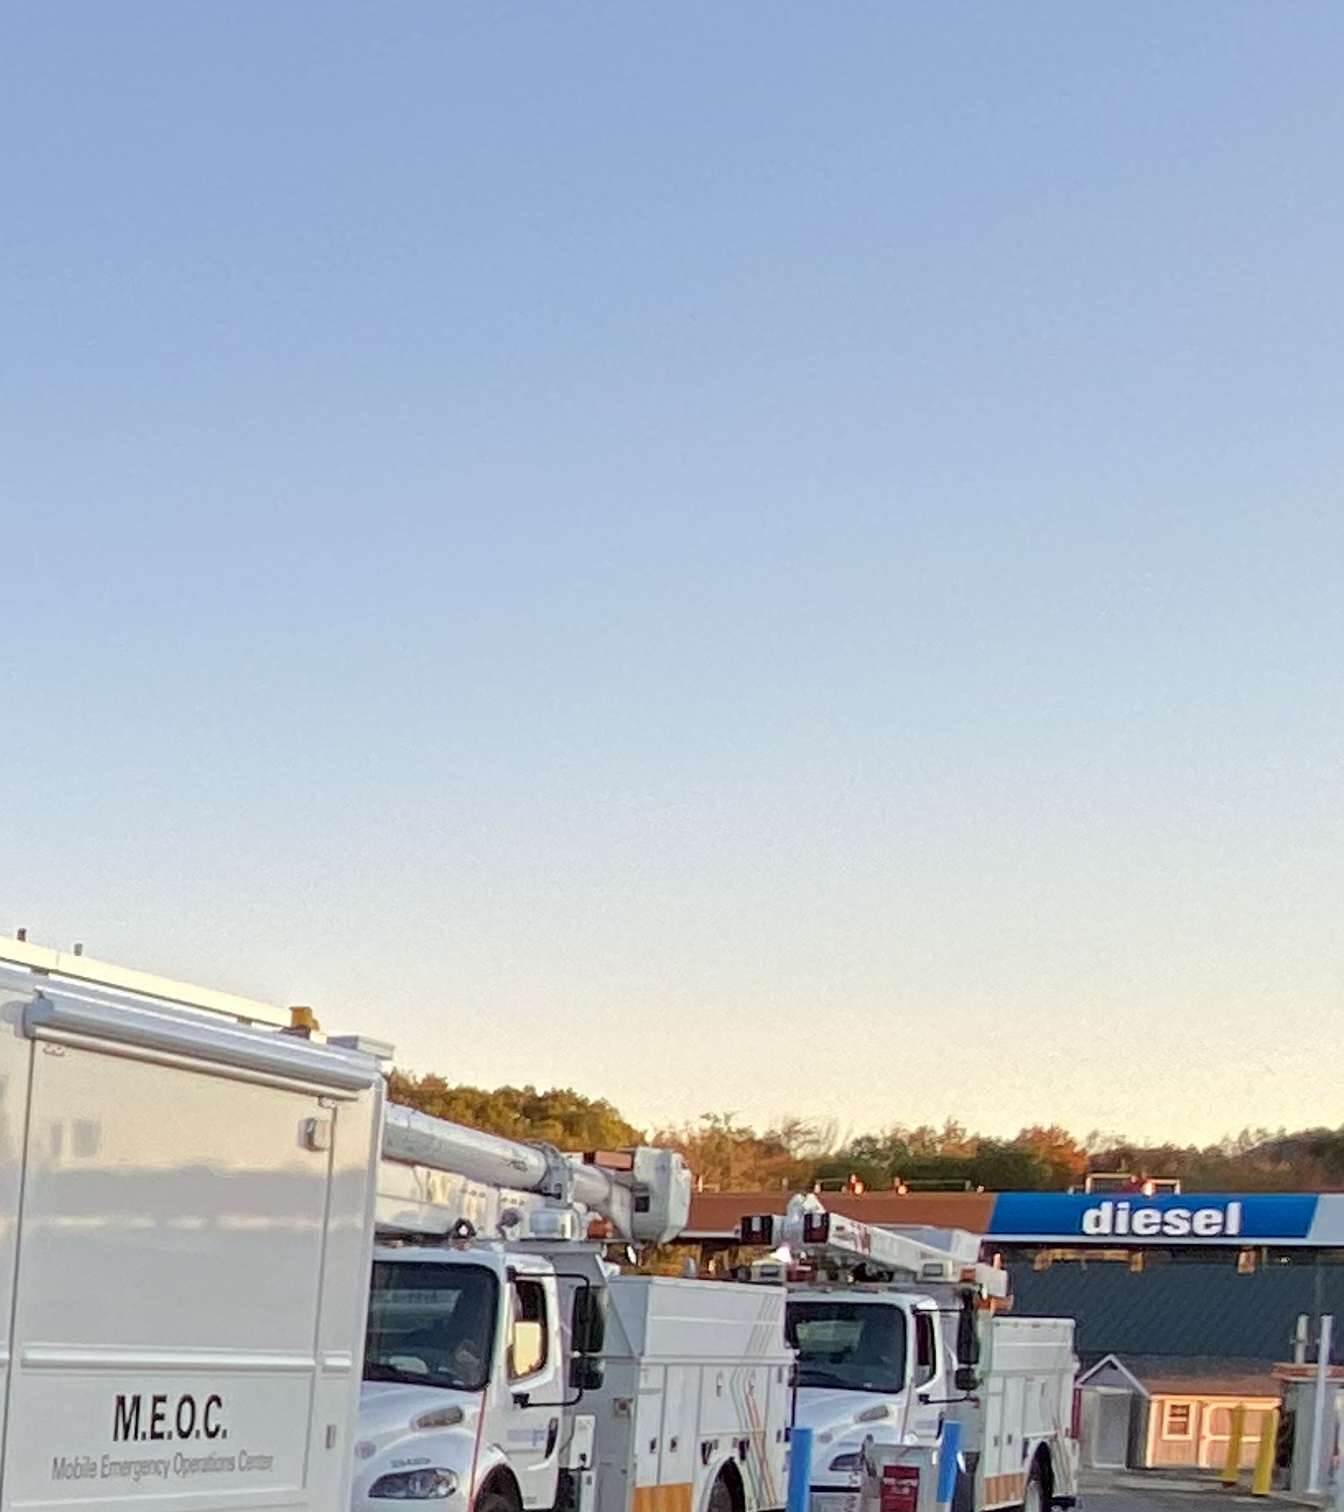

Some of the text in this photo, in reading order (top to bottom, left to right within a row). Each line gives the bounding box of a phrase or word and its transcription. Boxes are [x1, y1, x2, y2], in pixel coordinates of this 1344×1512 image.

[1082, 1201, 1242, 1236] diesel
[112, 1393, 229, 1442] M.E.O.C.
[51, 1449, 274, 1483] Mobile Emergency Operations Center
